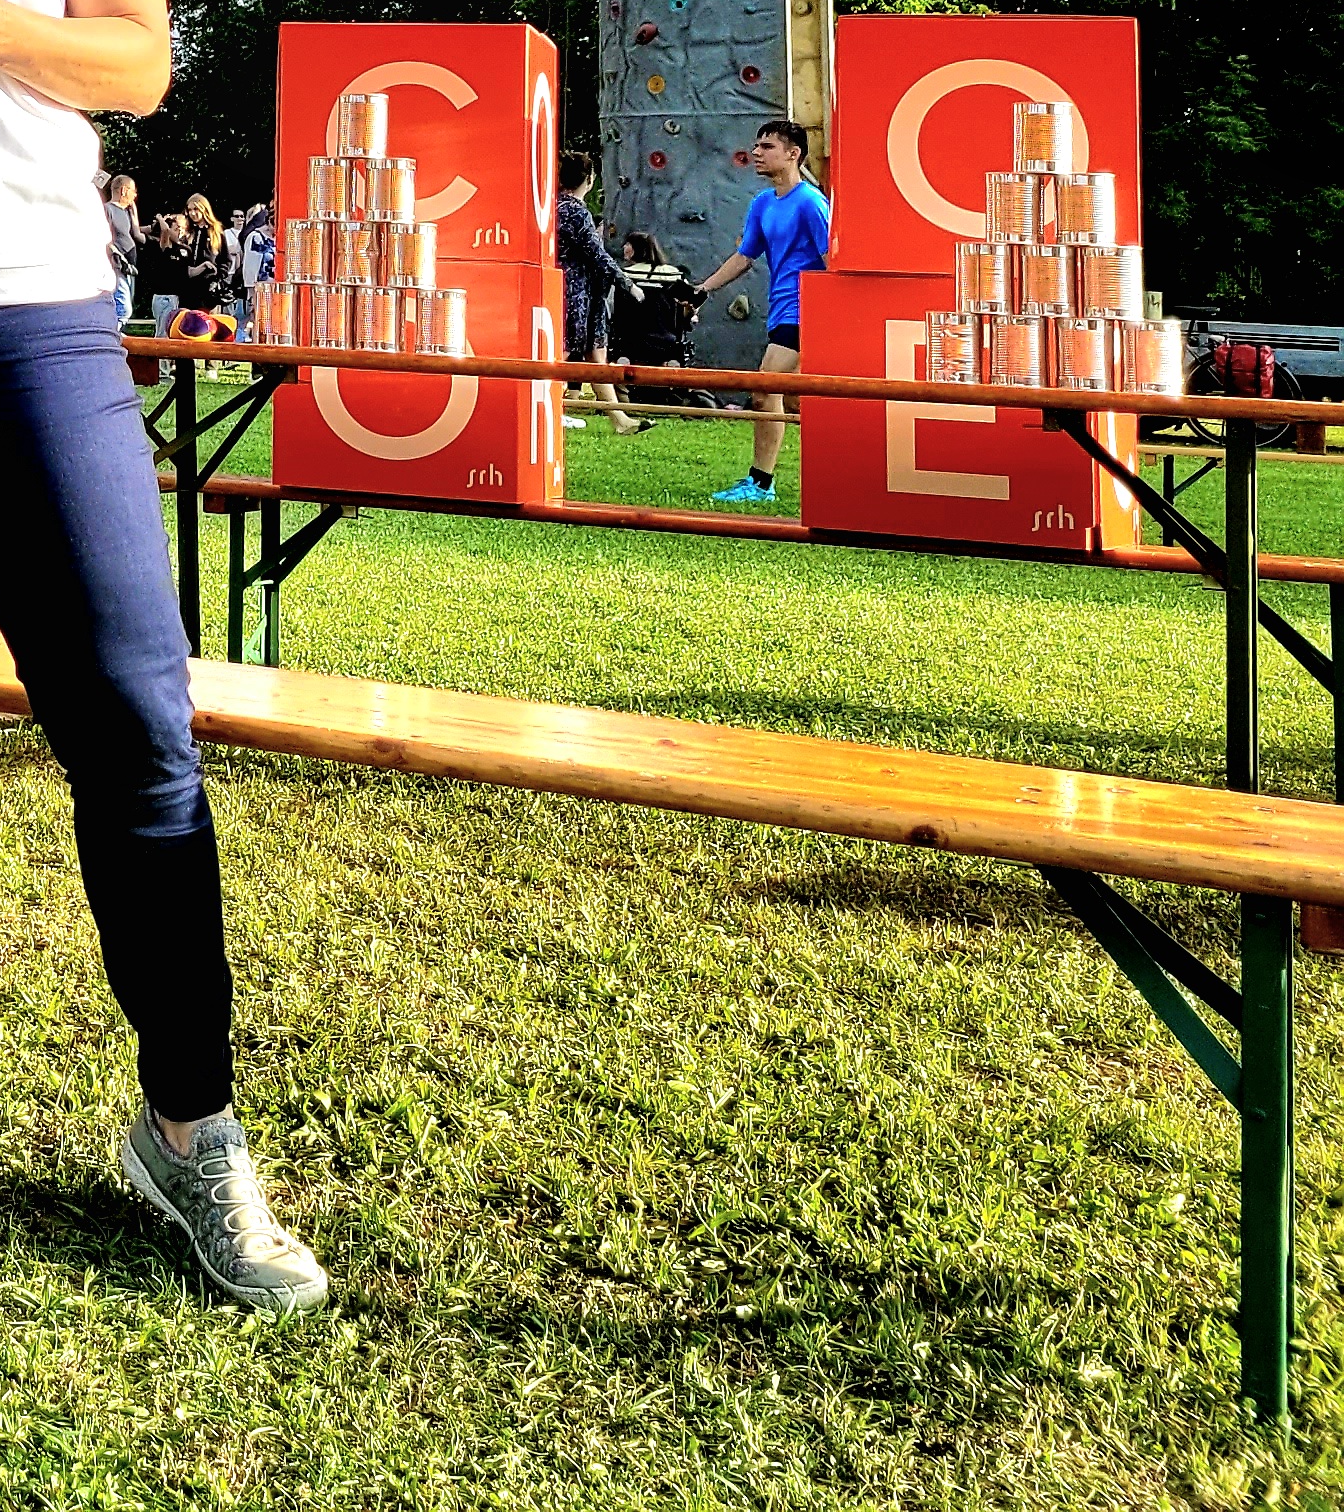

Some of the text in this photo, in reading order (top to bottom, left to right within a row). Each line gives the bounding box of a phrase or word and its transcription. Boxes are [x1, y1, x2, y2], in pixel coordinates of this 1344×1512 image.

[326, 61, 479, 222] C
[471, 222, 509, 248] srh
[885, 319, 1010, 500] E
[466, 463, 503, 488] srh
[1031, 504, 1075, 532] srh
